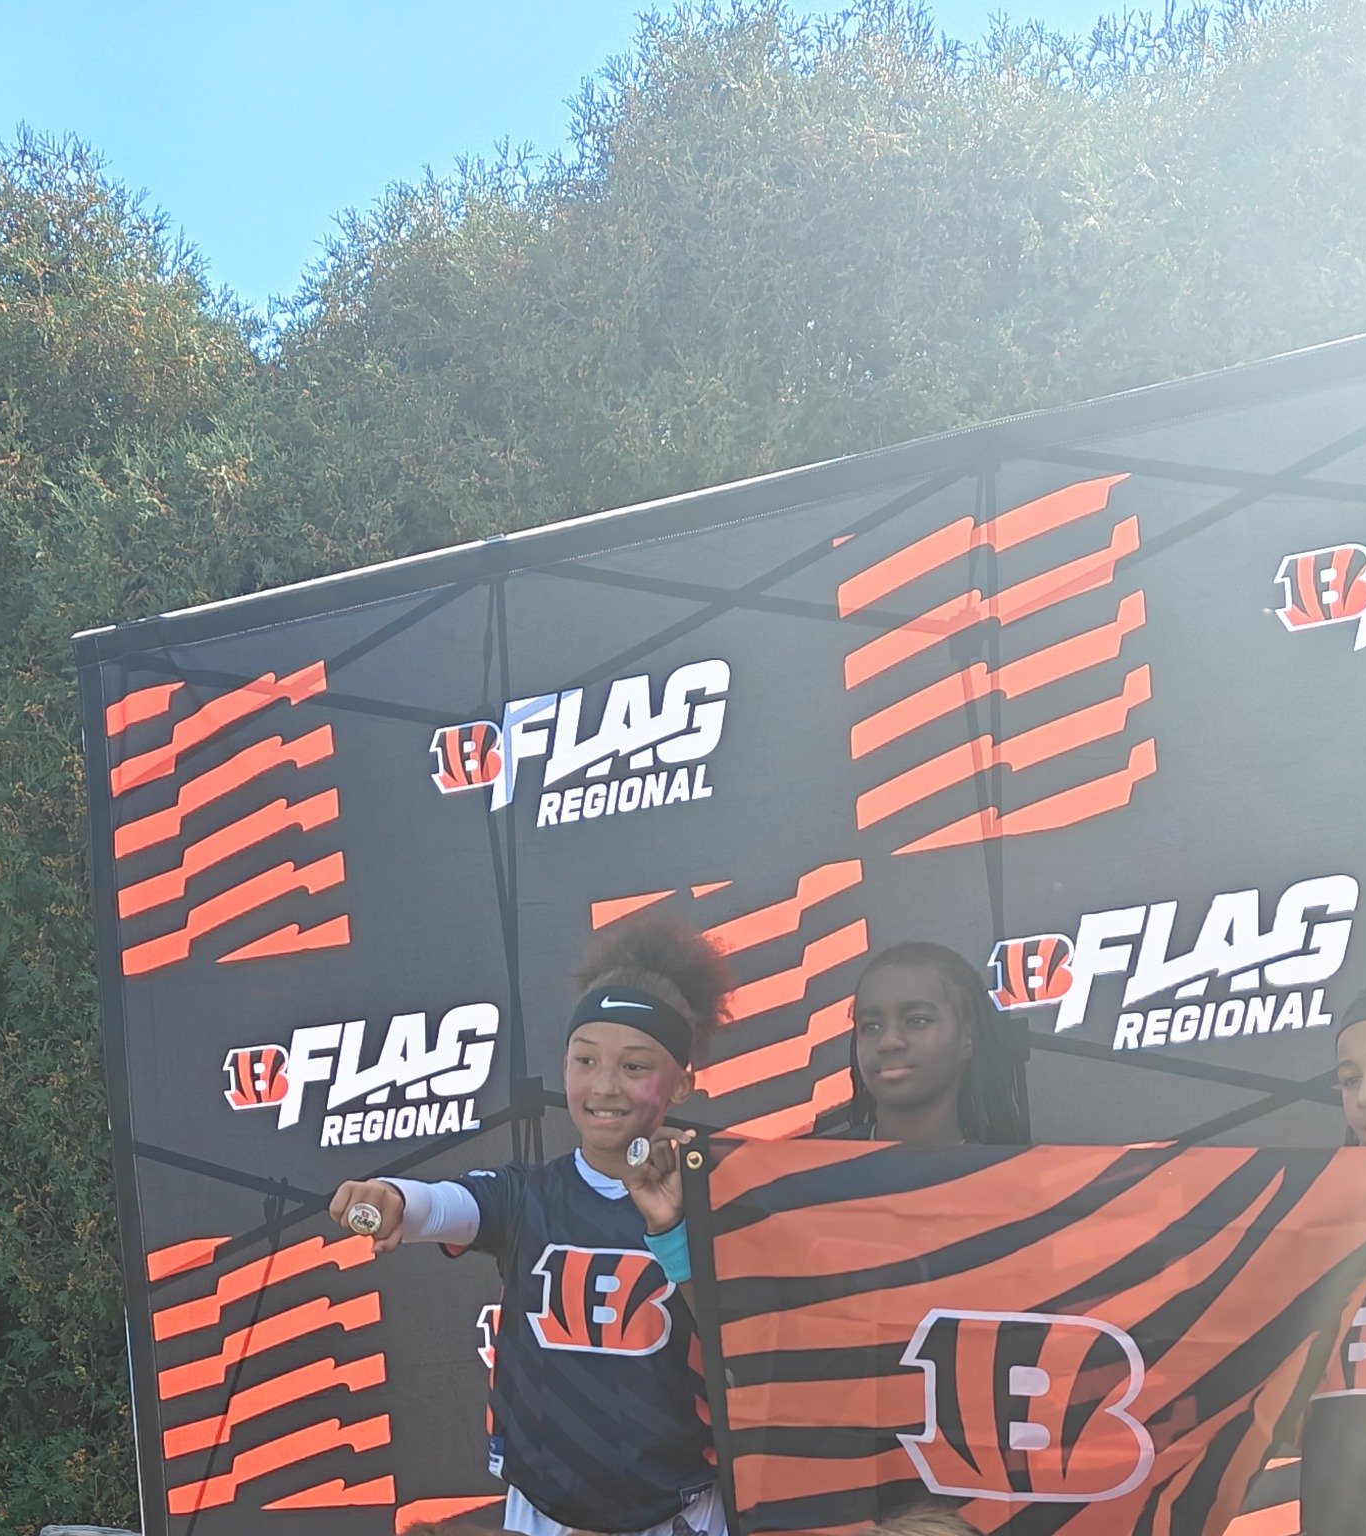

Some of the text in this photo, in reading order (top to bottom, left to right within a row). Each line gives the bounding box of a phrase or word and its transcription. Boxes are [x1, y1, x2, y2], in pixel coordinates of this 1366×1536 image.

[491, 658, 731, 811] FLAG
[537, 762, 713, 827] REGIONAL
[1055, 873, 1360, 1033] FLAG
[278, 1002, 500, 1129] FLAG
[1113, 987, 1332, 1050] REGIONAL
[320, 1095, 480, 1147] REGIONAL
